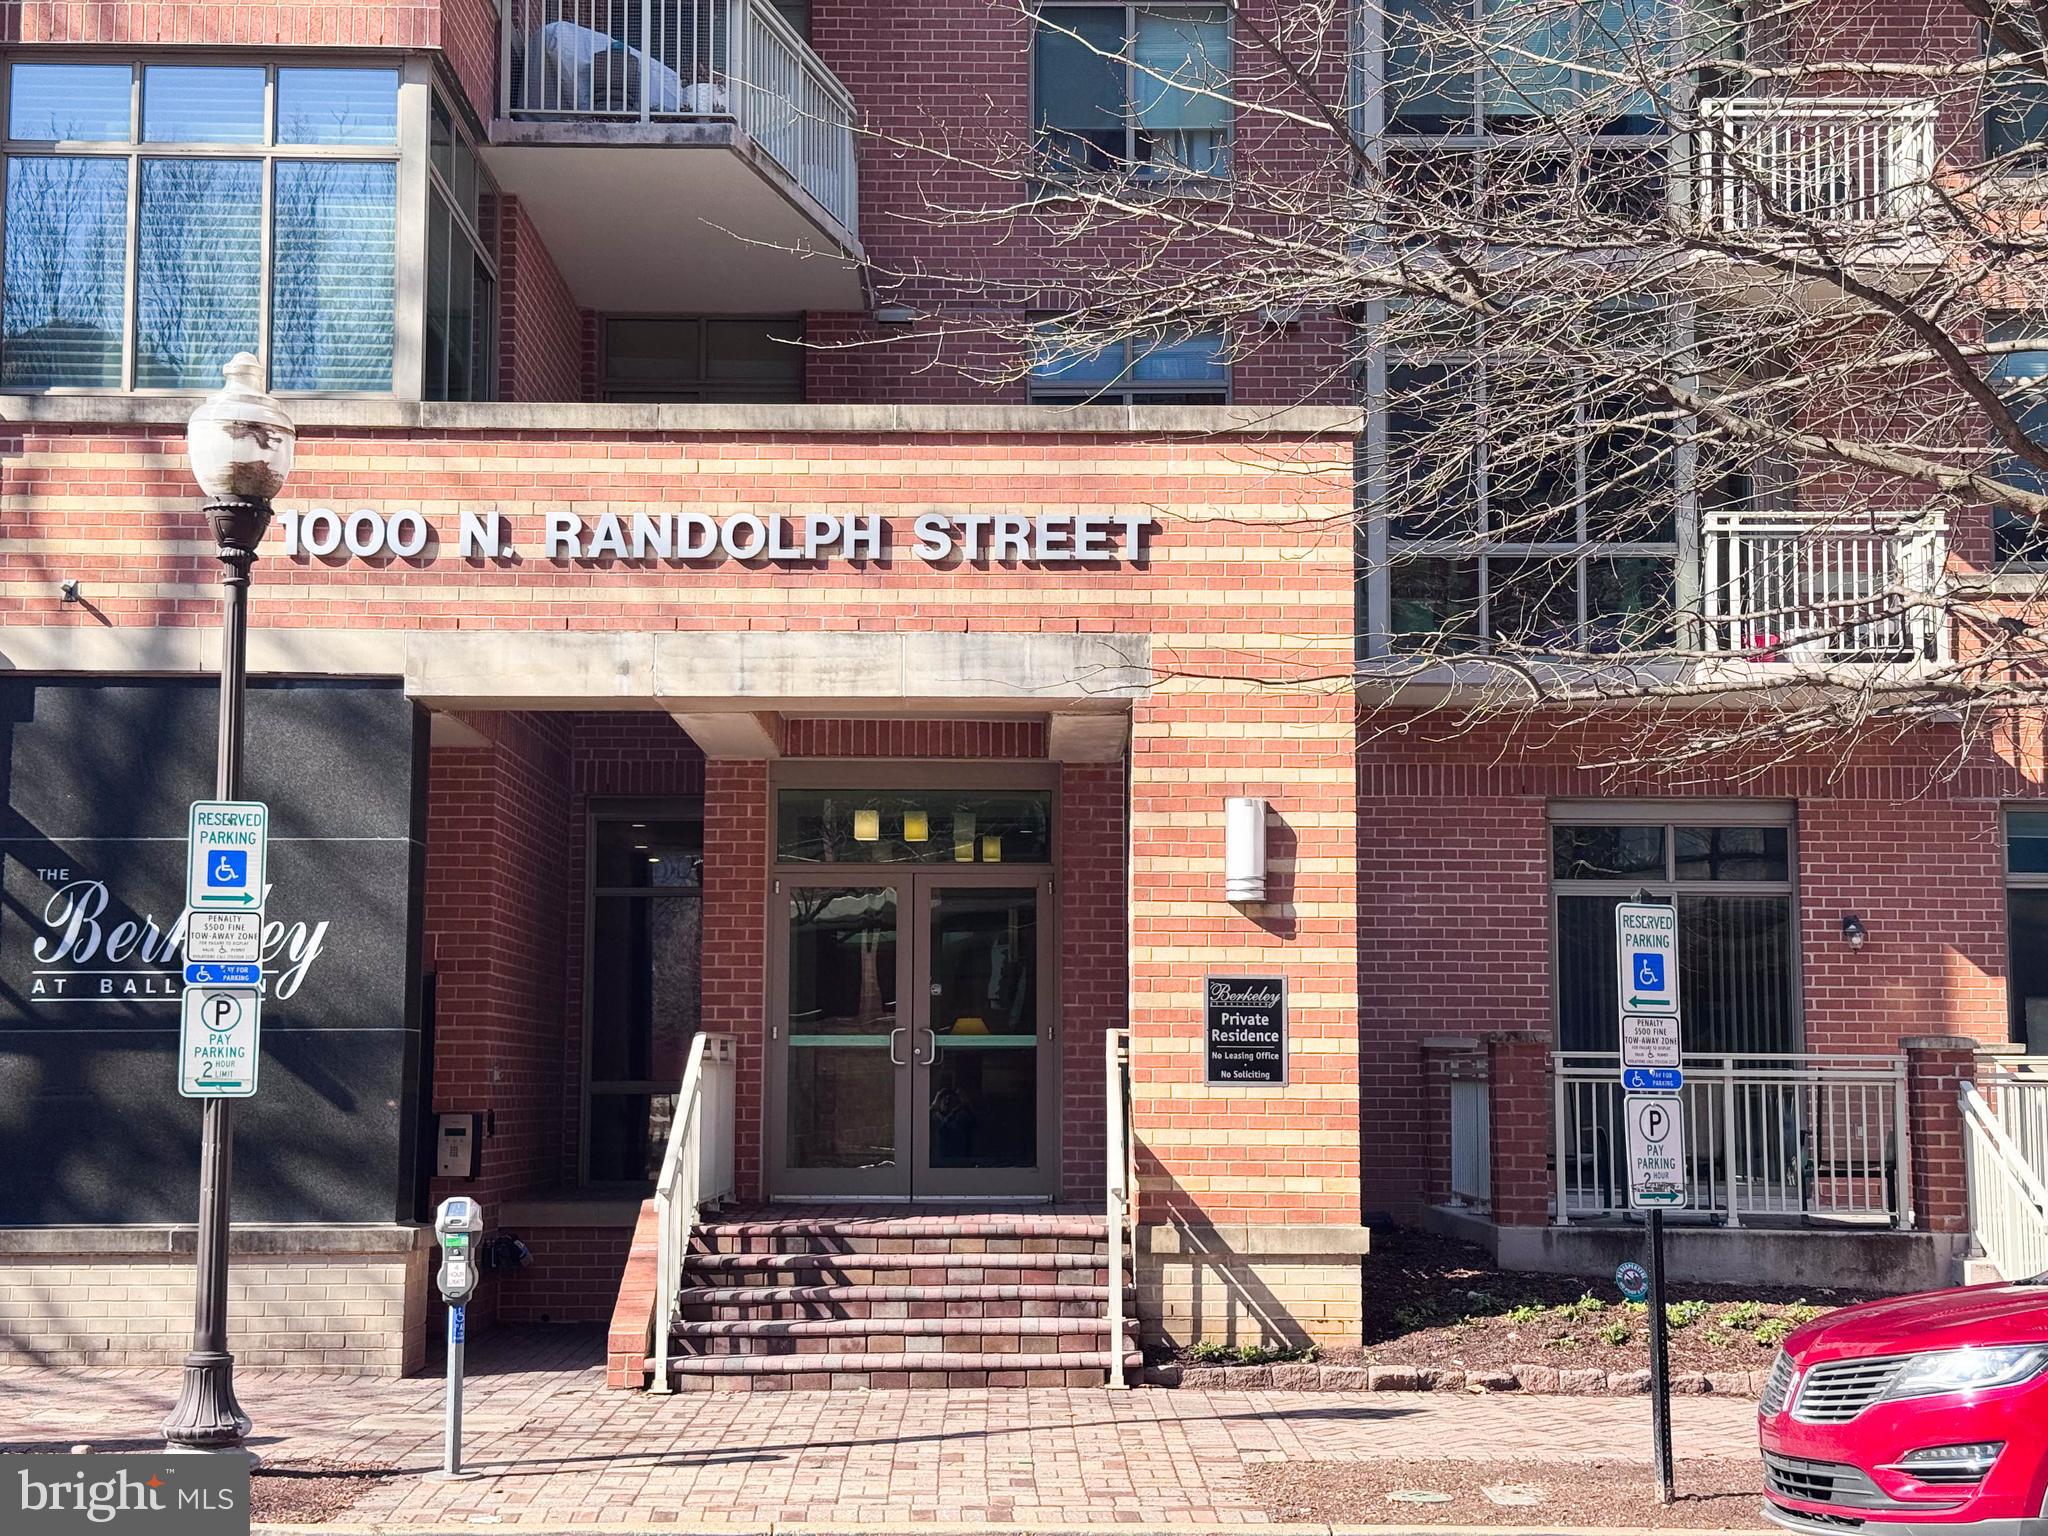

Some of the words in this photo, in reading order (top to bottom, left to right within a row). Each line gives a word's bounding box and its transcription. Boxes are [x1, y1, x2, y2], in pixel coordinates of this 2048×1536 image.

[277, 508, 427, 556] 1000
[459, 511, 513, 558] N.
[545, 511, 881, 559] RANDOLPH
[912, 513, 1152, 560] STREET
[198, 813, 261, 827] RESERVED
[200, 831, 257, 845] PARKING
[37, 869, 70, 880] THE
[204, 923, 225, 931] $500
[1623, 915, 1672, 930] RESERVED
[191, 932, 234, 940] TOW-AWAY
[1625, 933, 1670, 949] PARKING
[31, 979, 67, 994] AT
[100, 979, 267, 994] BALLN
[1210, 982, 1281, 1008] Berkeley
[215, 1000, 231, 1026] P
[1221, 1012, 1270, 1026] Private
[1637, 1019, 1664, 1027] PENALTY
[1211, 1029, 1279, 1042] Residence
[1634, 1027, 1651, 1035] $500
[1653, 1028, 1667, 1036] FINE
[209, 1034, 231, 1045] PAY
[1661, 1037, 1677, 1045] ZONE
[194, 1047, 246, 1059] PARKING
[1211, 1052, 1223, 1060] No
[1224, 1052, 1254, 1061] Leasing
[1256, 1052, 1279, 1060] Office
[203, 1062, 213, 1078] 2
[215, 1060, 236, 1068] HOUR
[215, 1070, 234, 1078] LIMIT
[1221, 1070, 1232, 1078] No
[1233, 1070, 1270, 1080] Soliciting
[1649, 1110, 1661, 1136] P
[1646, 1144, 1664, 1156] PAY
[1637, 1157, 1676, 1170] PARKING
[1643, 1172, 1652, 1189] 2
[1653, 1171, 1670, 1180] HOUR
